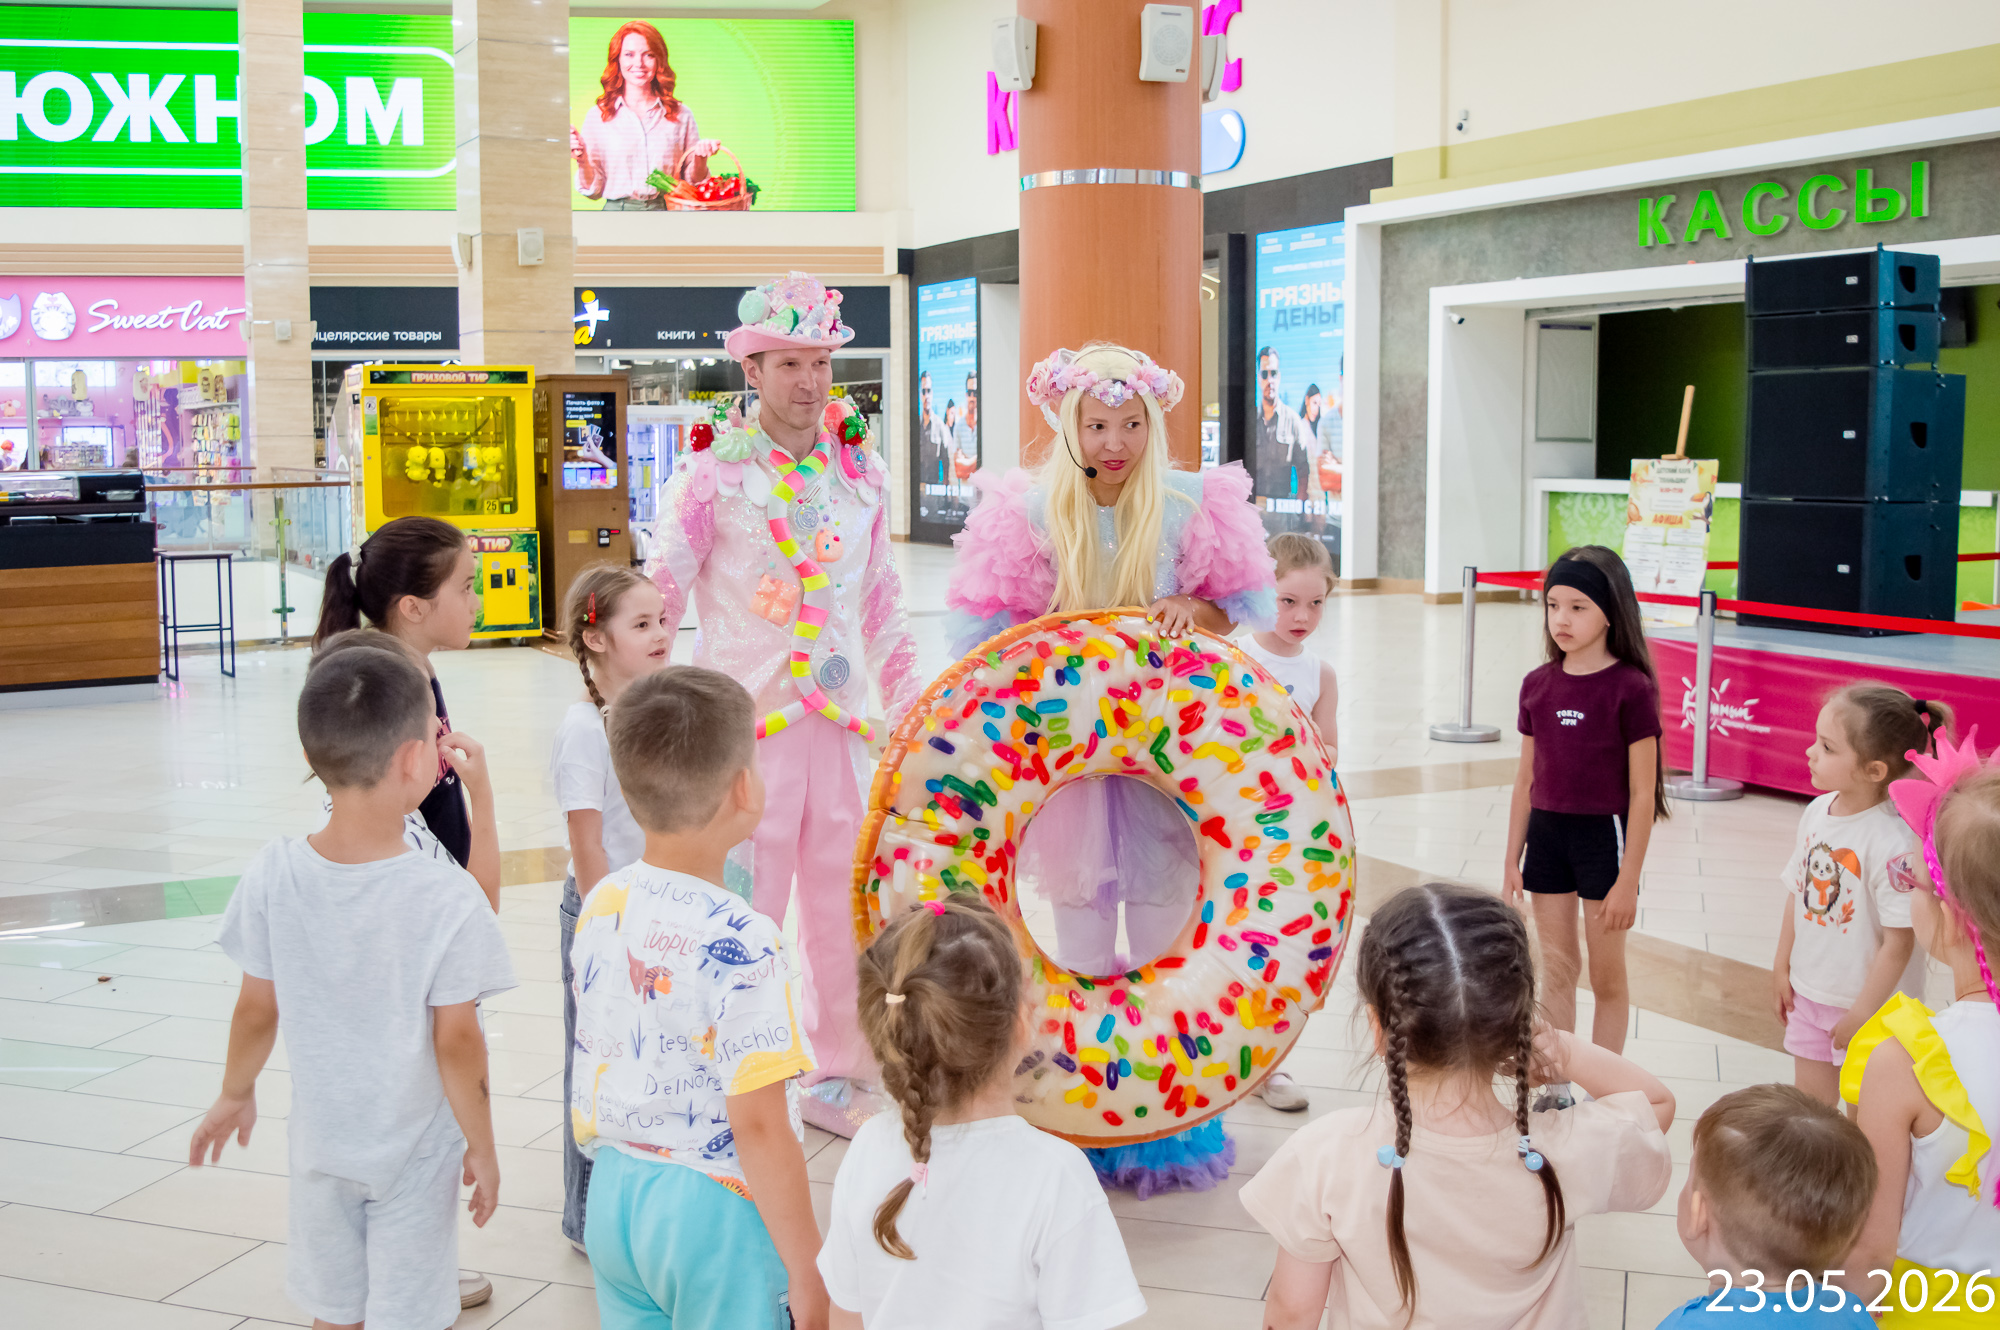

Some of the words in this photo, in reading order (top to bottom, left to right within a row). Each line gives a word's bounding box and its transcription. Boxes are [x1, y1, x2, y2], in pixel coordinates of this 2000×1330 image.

[1638, 160, 1930, 248] КАССЫ
[1259, 280, 1345, 309] ГРЯЗНЫ
[87, 299, 187, 333] Sweet
[180, 300, 246, 332] Cat
[1273, 303, 1344, 332] ДЕНЬГ
[393, 331, 442, 343] товары
[920, 321, 977, 342] ГРЯЗНЫЕ
[928, 339, 976, 360] ДЕНЬГИ
[411, 372, 467, 383] ПРИЗОВОЙ
[469, 372, 489, 383] ТИР
[486, 501, 497, 511] 25
[1651, 513, 1684, 525] АФИША
[480, 537, 511, 551] ТИР
[1556, 709, 1585, 720] TOKYO
[1560, 718, 1577, 726] JPN
